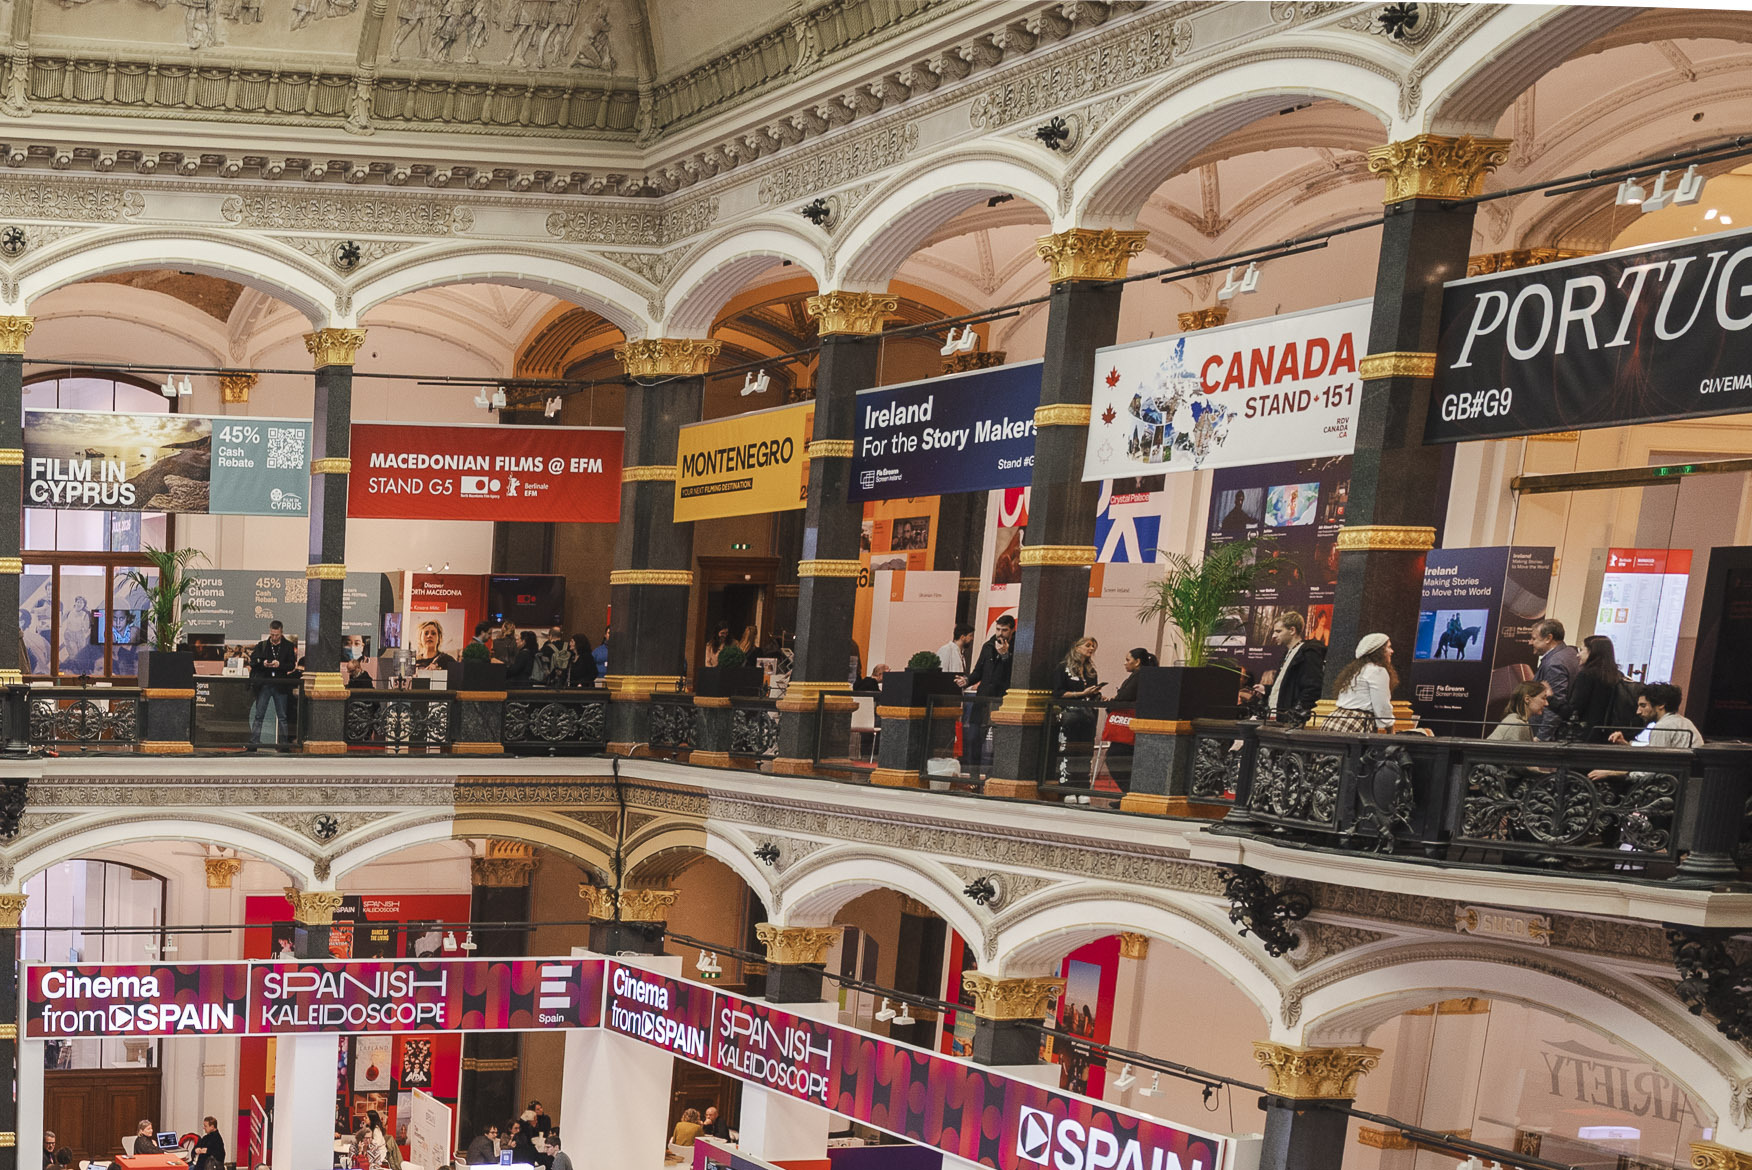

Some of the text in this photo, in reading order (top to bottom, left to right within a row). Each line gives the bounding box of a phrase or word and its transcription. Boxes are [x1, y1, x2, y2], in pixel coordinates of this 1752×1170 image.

[1700, 375, 1752, 395] CINEMA
[864, 395, 933, 430] Ireland
[1244, 383, 1354, 420] STAND 151
[1441, 387, 1512, 422] GB#G9
[1323, 424, 1348, 434] CANADA
[1336, 417, 1349, 425] RDV
[219, 426, 260, 444] 45%
[862, 416, 1038, 458] For the Story Makers
[218, 446, 244, 457] Cash
[218, 457, 254, 468] Rebate
[681, 436, 793, 478] MONTENEGRO
[30, 458, 126, 483] FILM IN
[369, 453, 603, 475] MACEDONIAN FILMS @ EFM
[997, 457, 1022, 471] Stand
[29, 480, 136, 505] CYPRUS
[368, 477, 453, 495] STAND G5
[271, 501, 302, 510] CYPRUS
[1423, 577, 1479, 587] Making Stories
[1424, 566, 1458, 576] Ireland
[188, 587, 224, 597] Cinema
[256, 578, 281, 589] 45%
[1422, 589, 1430, 597] to
[1468, 587, 1492, 596] World
[40, 971, 161, 1001] Cinema
[262, 969, 448, 1001] SPANISH
[612, 968, 669, 1012] Cinema
[41, 1002, 235, 1033] from SPAIN
[261, 1002, 446, 1027] KALEIDOSCOPE
[538, 1012, 566, 1024] Spain
[611, 997, 706, 1059] from SPAIN
[719, 1008, 833, 1072] SPANISH
[716, 1041, 829, 1103] KALEIDOSCOPE
